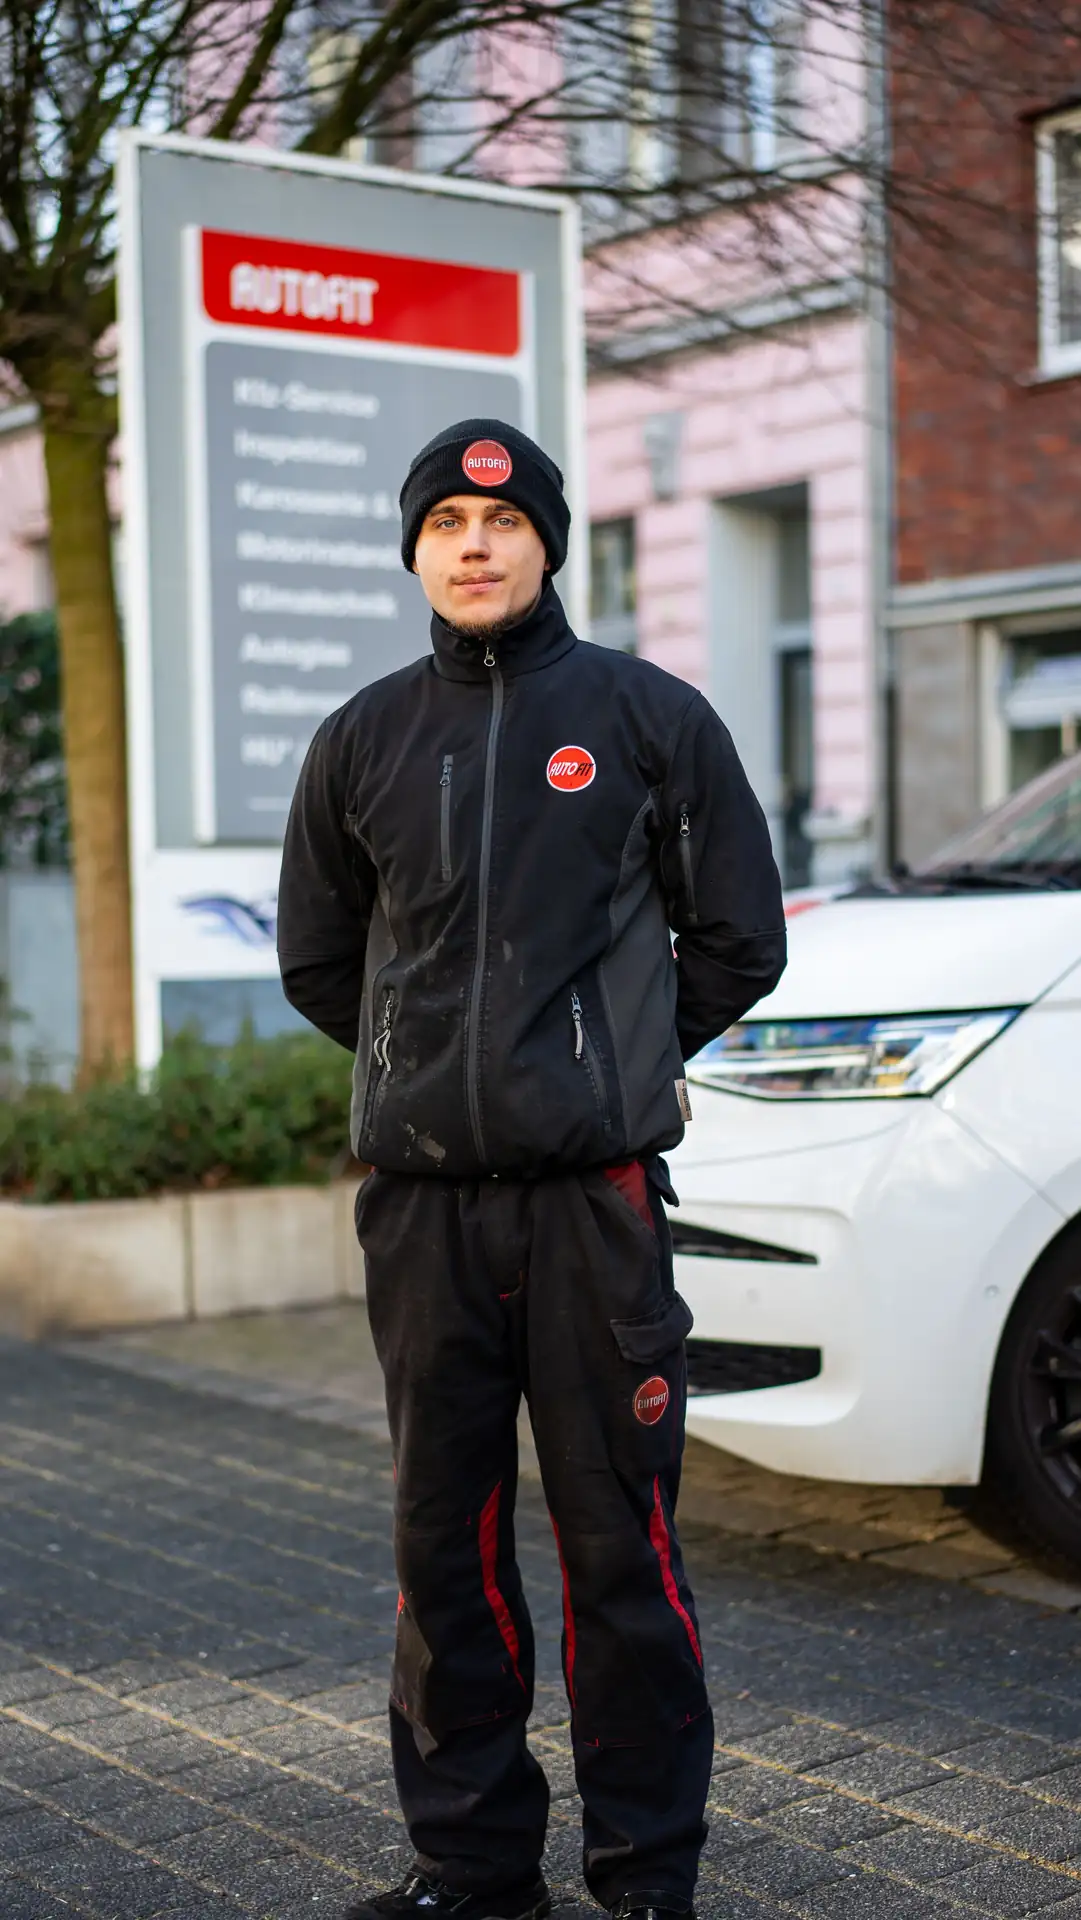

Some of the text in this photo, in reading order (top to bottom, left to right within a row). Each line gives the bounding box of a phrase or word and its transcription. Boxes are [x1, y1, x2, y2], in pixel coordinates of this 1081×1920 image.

[230, 262, 379, 326] AUTOFIT
[467, 457, 507, 470] AUTOFIT
[548, 761, 594, 777] AUTOFIT
[637, 1392, 667, 1410] AUTOFIT
